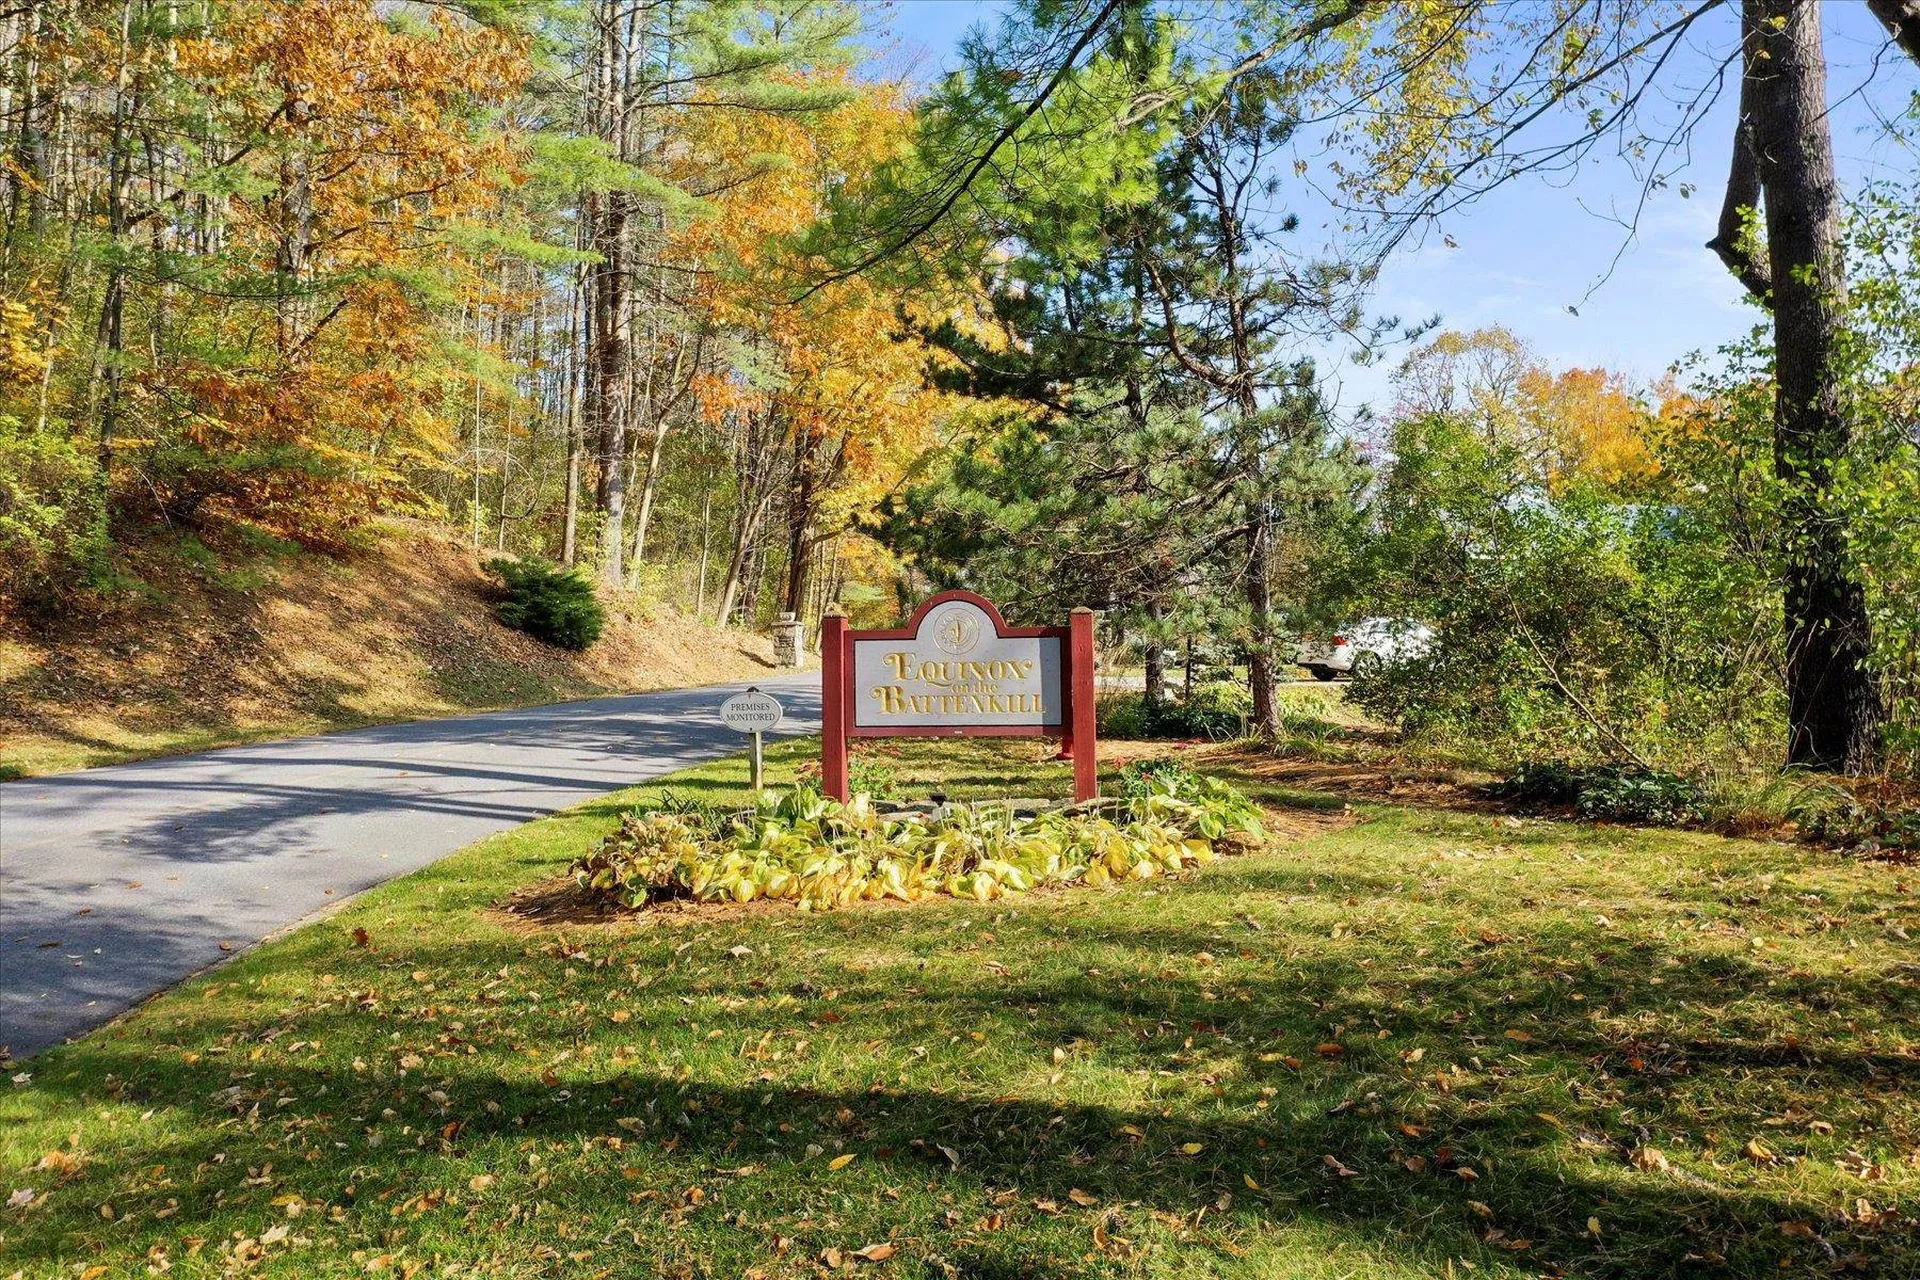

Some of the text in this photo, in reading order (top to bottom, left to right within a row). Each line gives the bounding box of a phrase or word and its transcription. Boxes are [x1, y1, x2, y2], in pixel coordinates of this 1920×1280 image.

[882, 652, 1033, 687] EQUINOX
[950, 682, 998, 694] on the
[869, 685, 1046, 714] BATTENKILL
[731, 703, 770, 711] PREMISES
[726, 713, 775, 721] MONITORED
